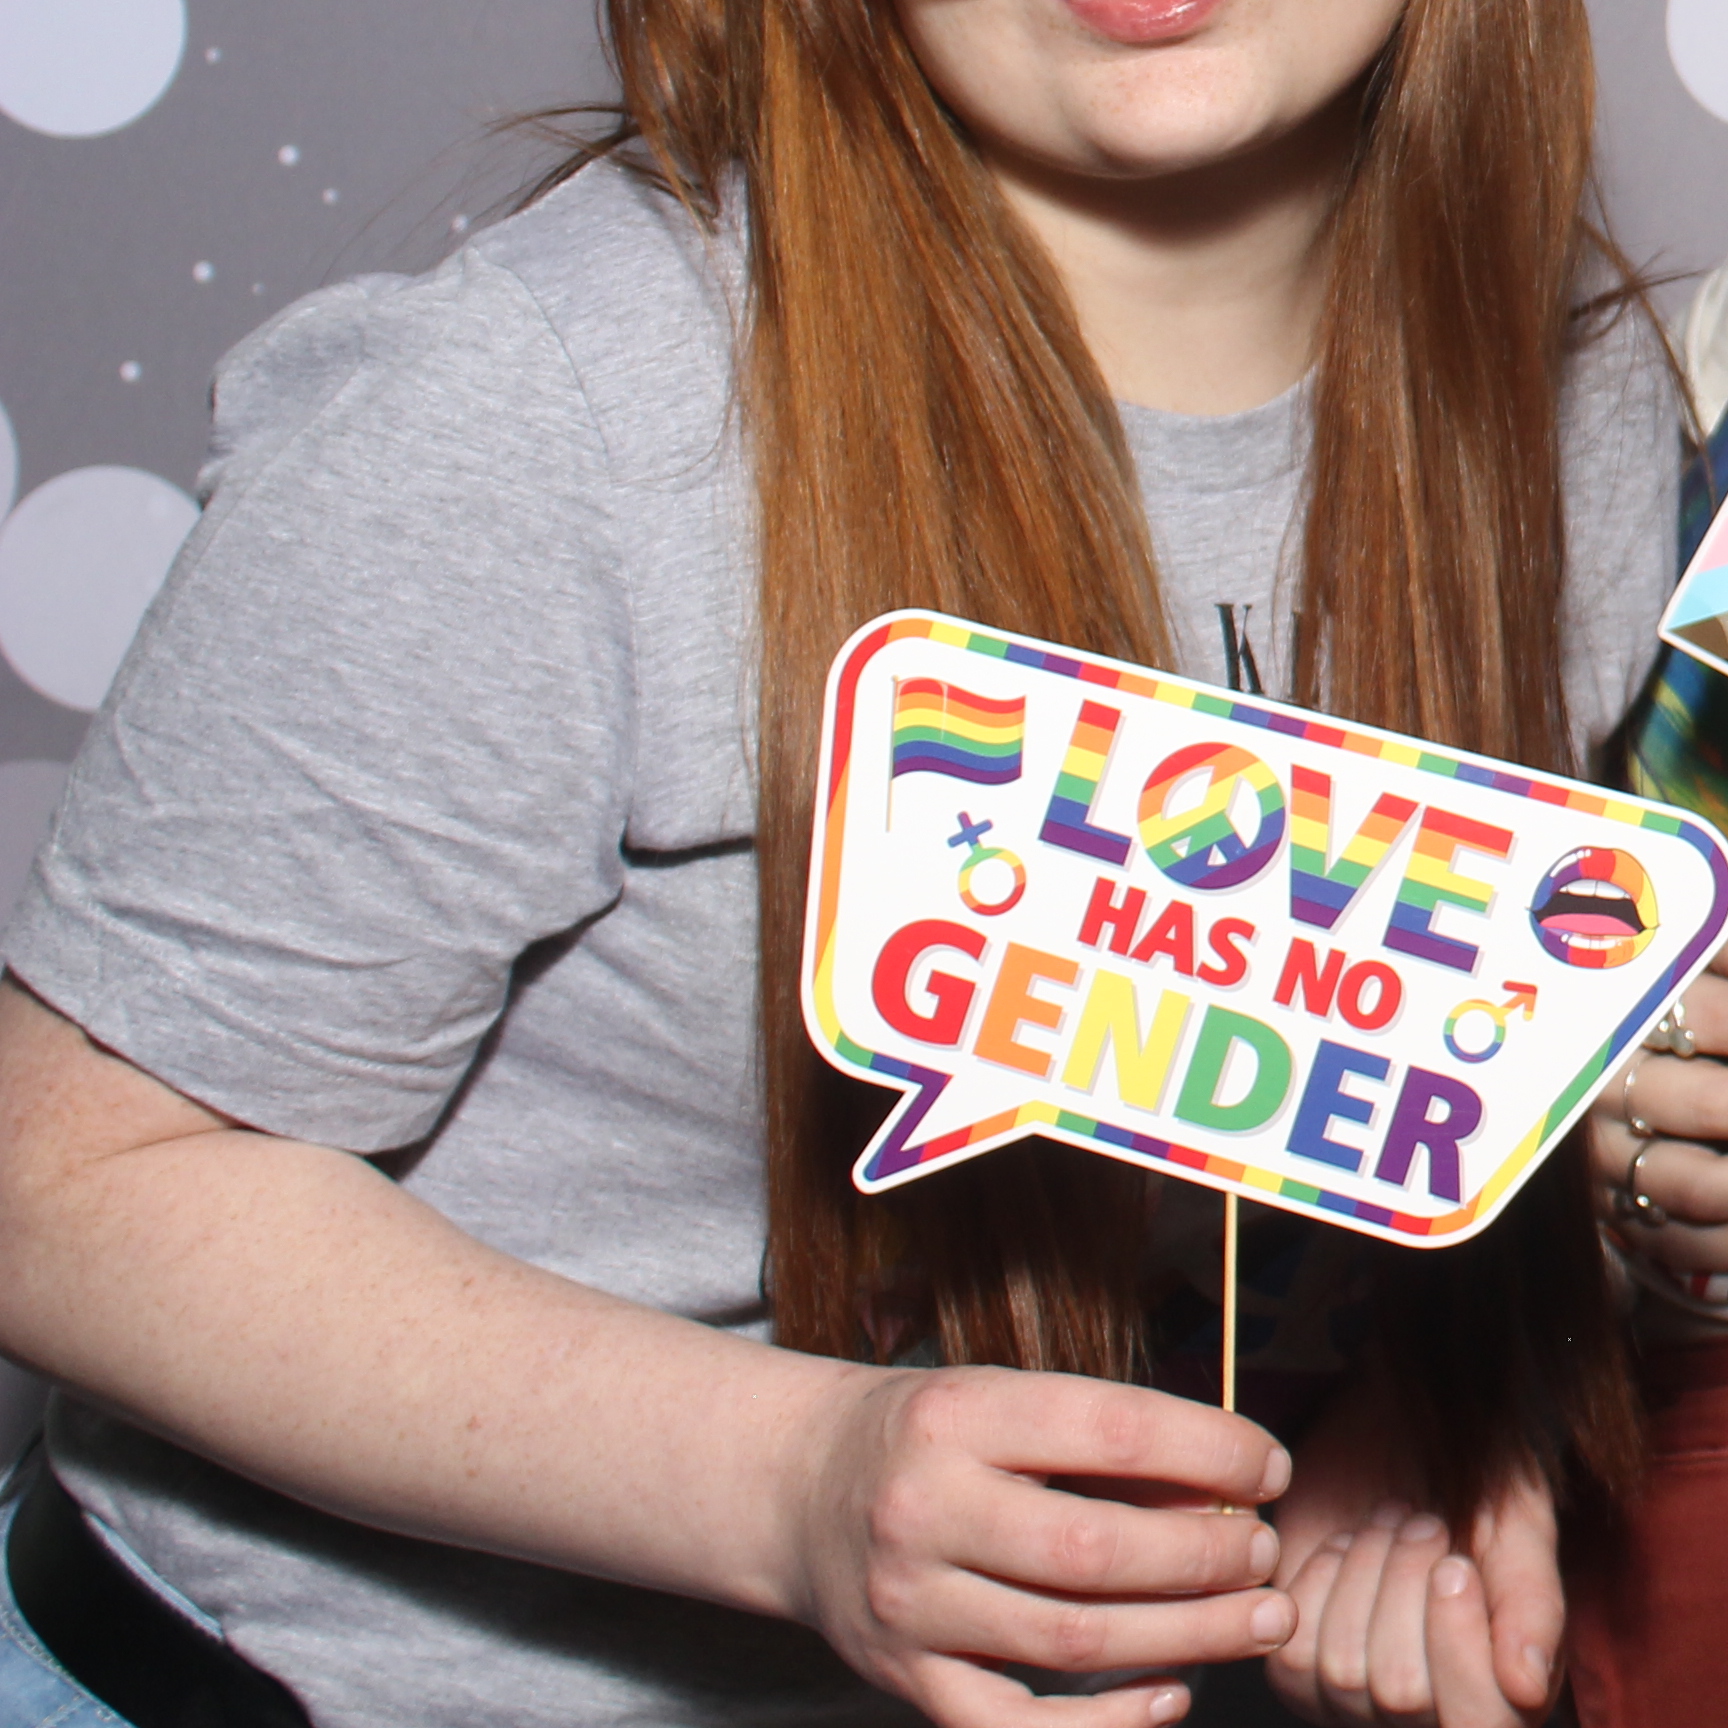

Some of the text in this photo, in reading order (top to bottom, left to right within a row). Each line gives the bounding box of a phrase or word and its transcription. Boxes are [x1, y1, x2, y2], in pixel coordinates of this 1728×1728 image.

[1040, 698, 1515, 972] LOVE
[1077, 876, 1404, 1031] HAS NO
[871, 918, 1484, 1204] GENDER
